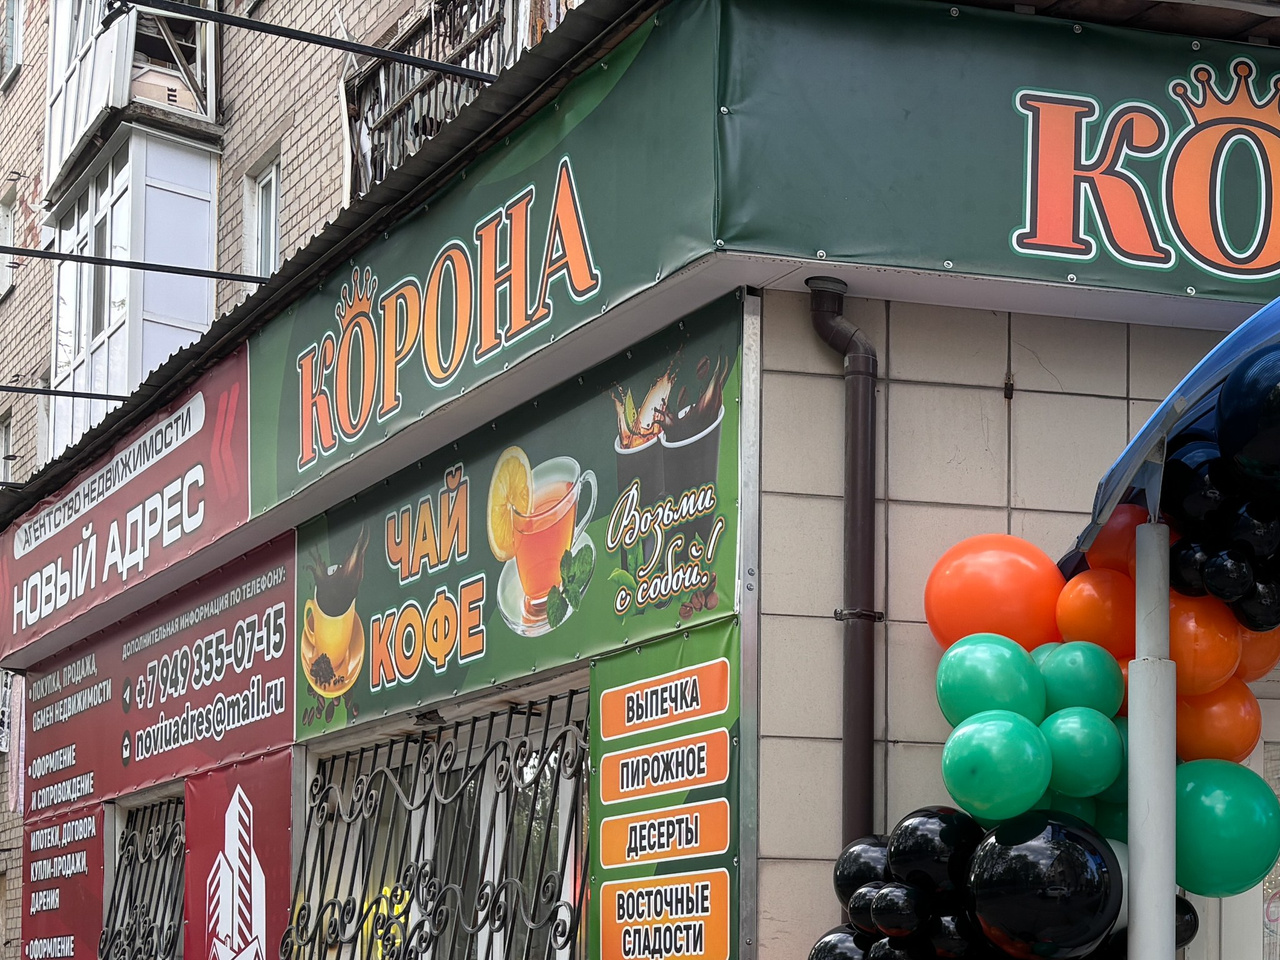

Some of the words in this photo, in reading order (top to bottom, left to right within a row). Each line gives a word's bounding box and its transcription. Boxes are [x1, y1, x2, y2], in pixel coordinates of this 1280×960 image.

[297, 153, 600, 473] КОРОНА
[22, 496, 82, 551] АГЕНТСТВО
[83, 406, 192, 505] НЕДВИЖИМОСТИ
[13, 523, 97, 634] НОВЫЙ
[102, 463, 205, 581] АДРЕС
[385, 462, 470, 585] ЧАЙ
[605, 479, 716, 577] Возьми
[615, 582, 633, 614] с
[637, 519, 724, 606] собой!
[122, 619, 179, 661] ДОПОЛНИТЕЛЬНАЯ
[180, 593, 229, 630] ИНФОРМАЦИЯ
[230, 588, 241, 606] ПО
[242, 566, 286, 598] ТЕЛЕФОНУ:
[370, 573, 487, 691] КОФЕ
[32, 670, 62, 702] ПОКУПКА,
[63, 653, 98, 687] ПРОДАЖА,
[159, 645, 191, 703] 949
[191, 602, 286, 690] 355-07-15
[32, 704, 54, 732] ОБМЕН
[55, 678, 112, 723] НЕДВИЖИМОСТИ
[135, 675, 286, 761] noviuadres@mail.ru
[624, 675, 700, 727] ВЫПЕЧКА
[31, 743, 76, 779] ОФОРМЛЕНИЕ
[619, 742, 707, 793] ПИРОЖНОЕ
[31, 790, 36, 811] И
[37, 771, 94, 810] СОПРОВОЖДЕНИЕ
[30, 825, 61, 852] ИПОТЕКИ,
[62, 815, 97, 848] ДОГОВОРА
[625, 812, 700, 861] ДЕСЕРТЫ
[30, 850, 88, 882] КУПЛИ-ПРОДАЖИ,
[30, 888, 60, 915] ДАРЕНИЯ
[615, 881, 711, 924] ВОСТОЧНЫЕ
[29, 935, 75, 960] ОФОРМЛЕНИЕ
[621, 920, 705, 960] СЛАДОСТИ
